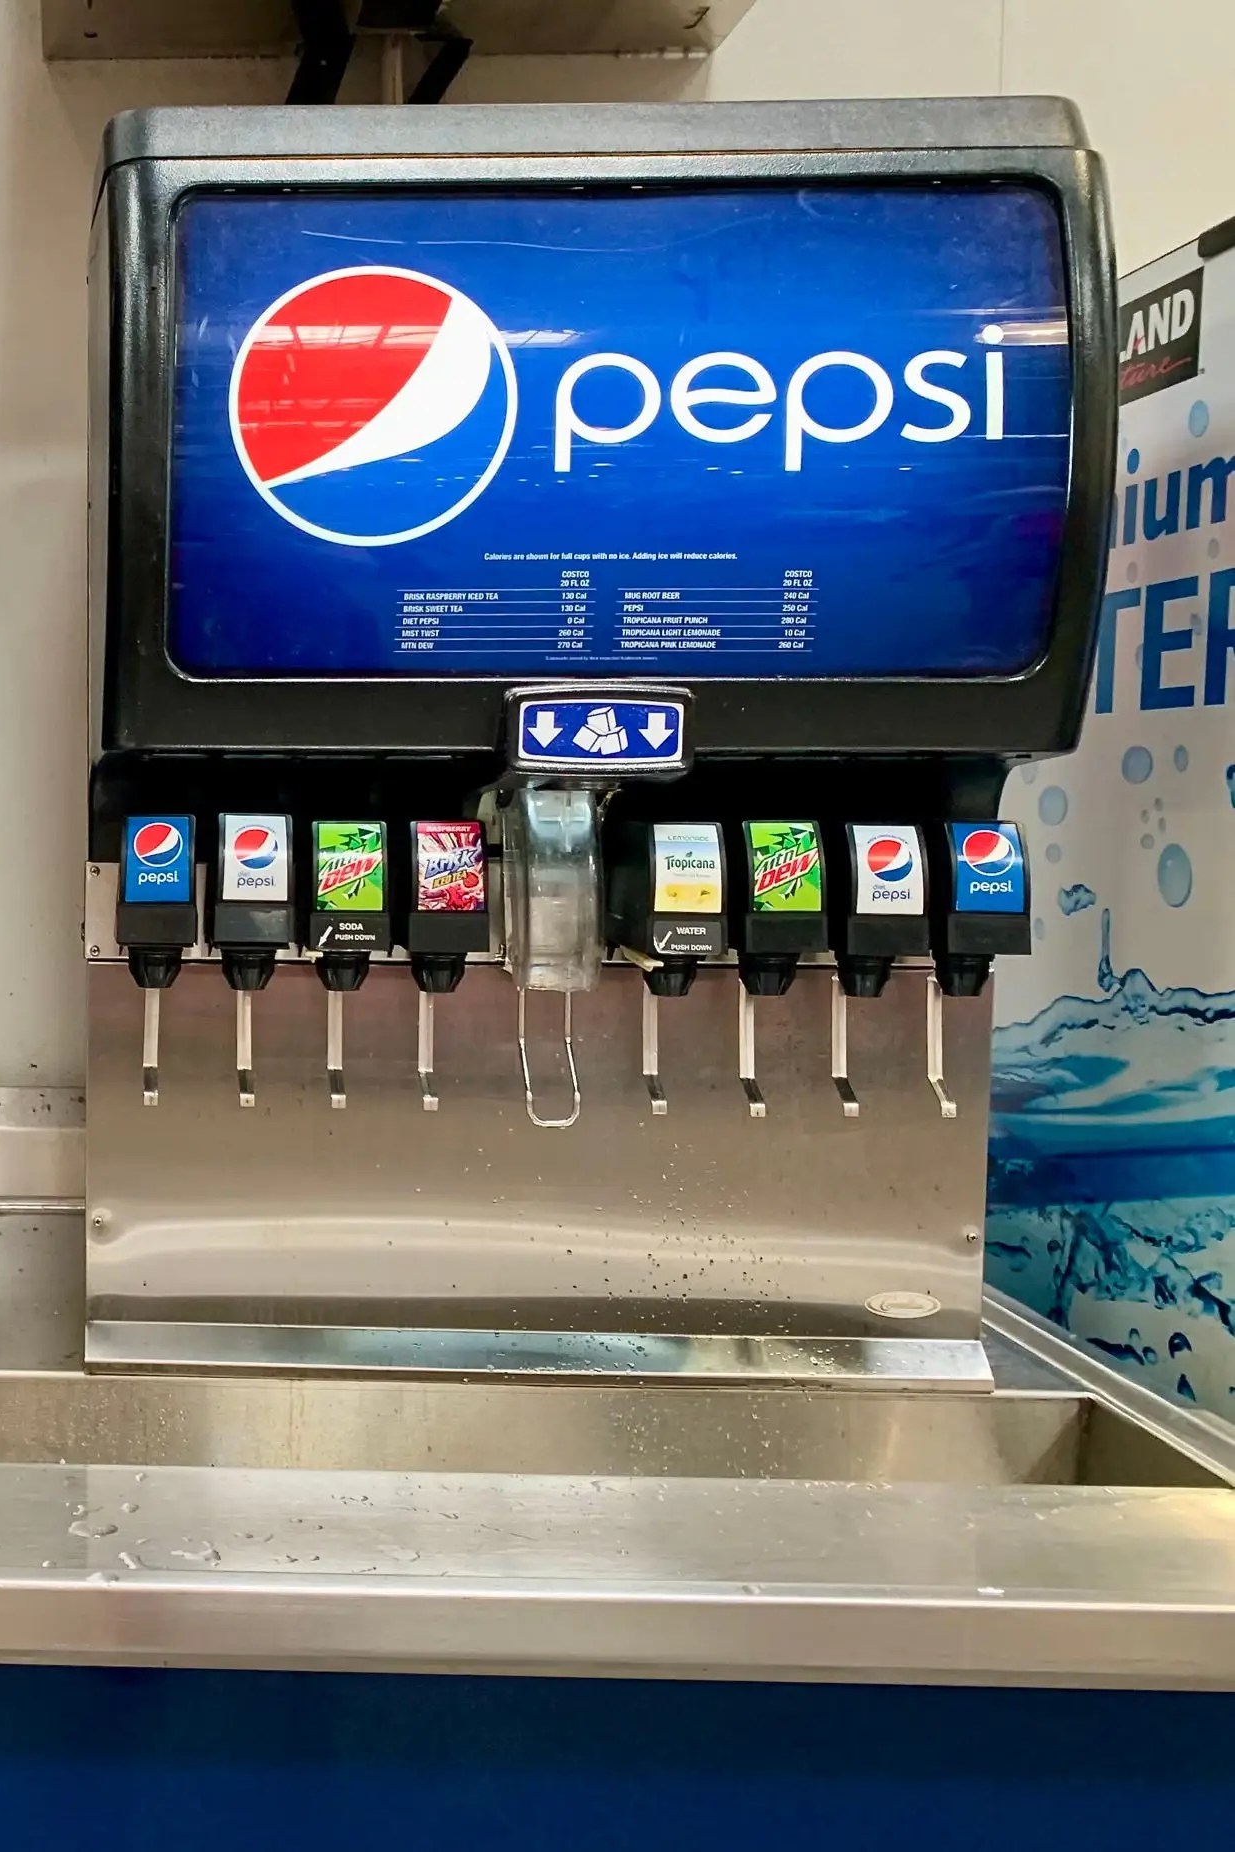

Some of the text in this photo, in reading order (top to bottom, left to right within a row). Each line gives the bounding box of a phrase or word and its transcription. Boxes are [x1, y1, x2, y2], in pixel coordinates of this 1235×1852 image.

[1120, 288, 1194, 363] AND
[554, 324, 1003, 472] pepsi
[484, 553, 512, 561] Calories
[561, 552, 572, 560] full
[592, 552, 607, 560] with
[632, 552, 656, 561] Adding
[669, 552, 682, 560] will
[684, 552, 707, 560] reduce
[709, 552, 737, 560] calories.
[623, 604, 643, 612] PEPSI
[783, 604, 808, 612] 250 Cal
[559, 629, 584, 637] 260 Cal
[558, 641, 583, 649] 270 Cal
[779, 641, 804, 649] 260 Cal
[665, 855, 715, 870] Tropicana
[138, 871, 179, 885] pepsi
[237, 876, 274, 888] pepsi
[970, 881, 1013, 894] pepsi
[872, 889, 911, 901] pepsi
[676, 927, 706, 935] WATER
